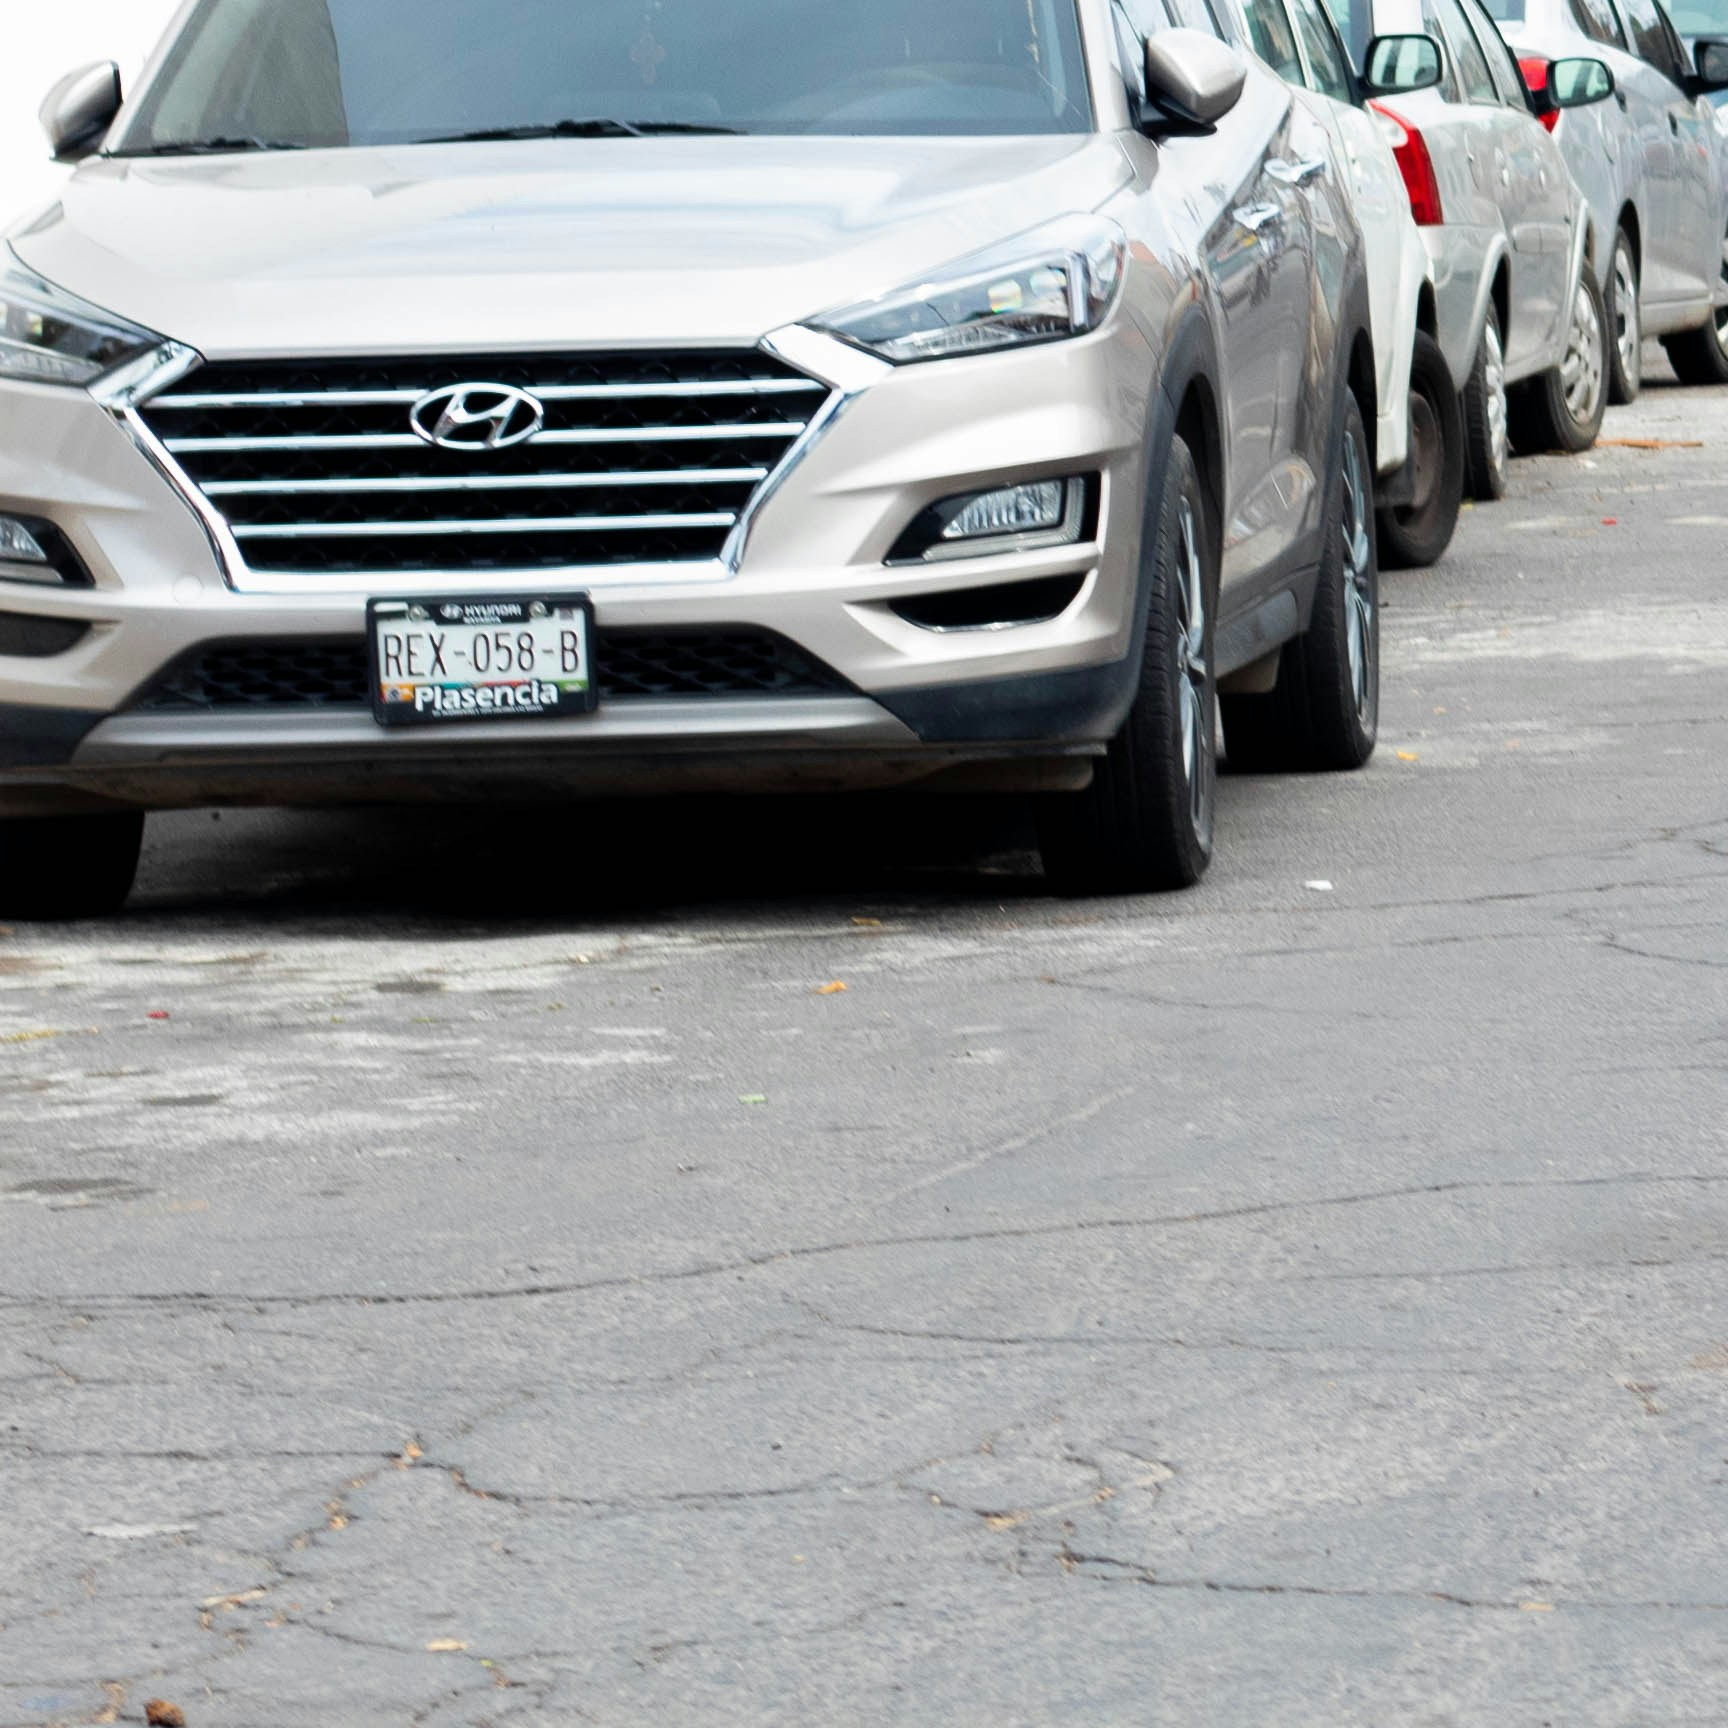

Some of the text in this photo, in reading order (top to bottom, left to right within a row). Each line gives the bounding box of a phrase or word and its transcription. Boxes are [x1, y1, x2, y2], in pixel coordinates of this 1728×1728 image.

[463, 603, 522, 617] HYUNDAI
[384, 630, 580, 677] REX-058-B
[414, 679, 560, 713] Plasencia
